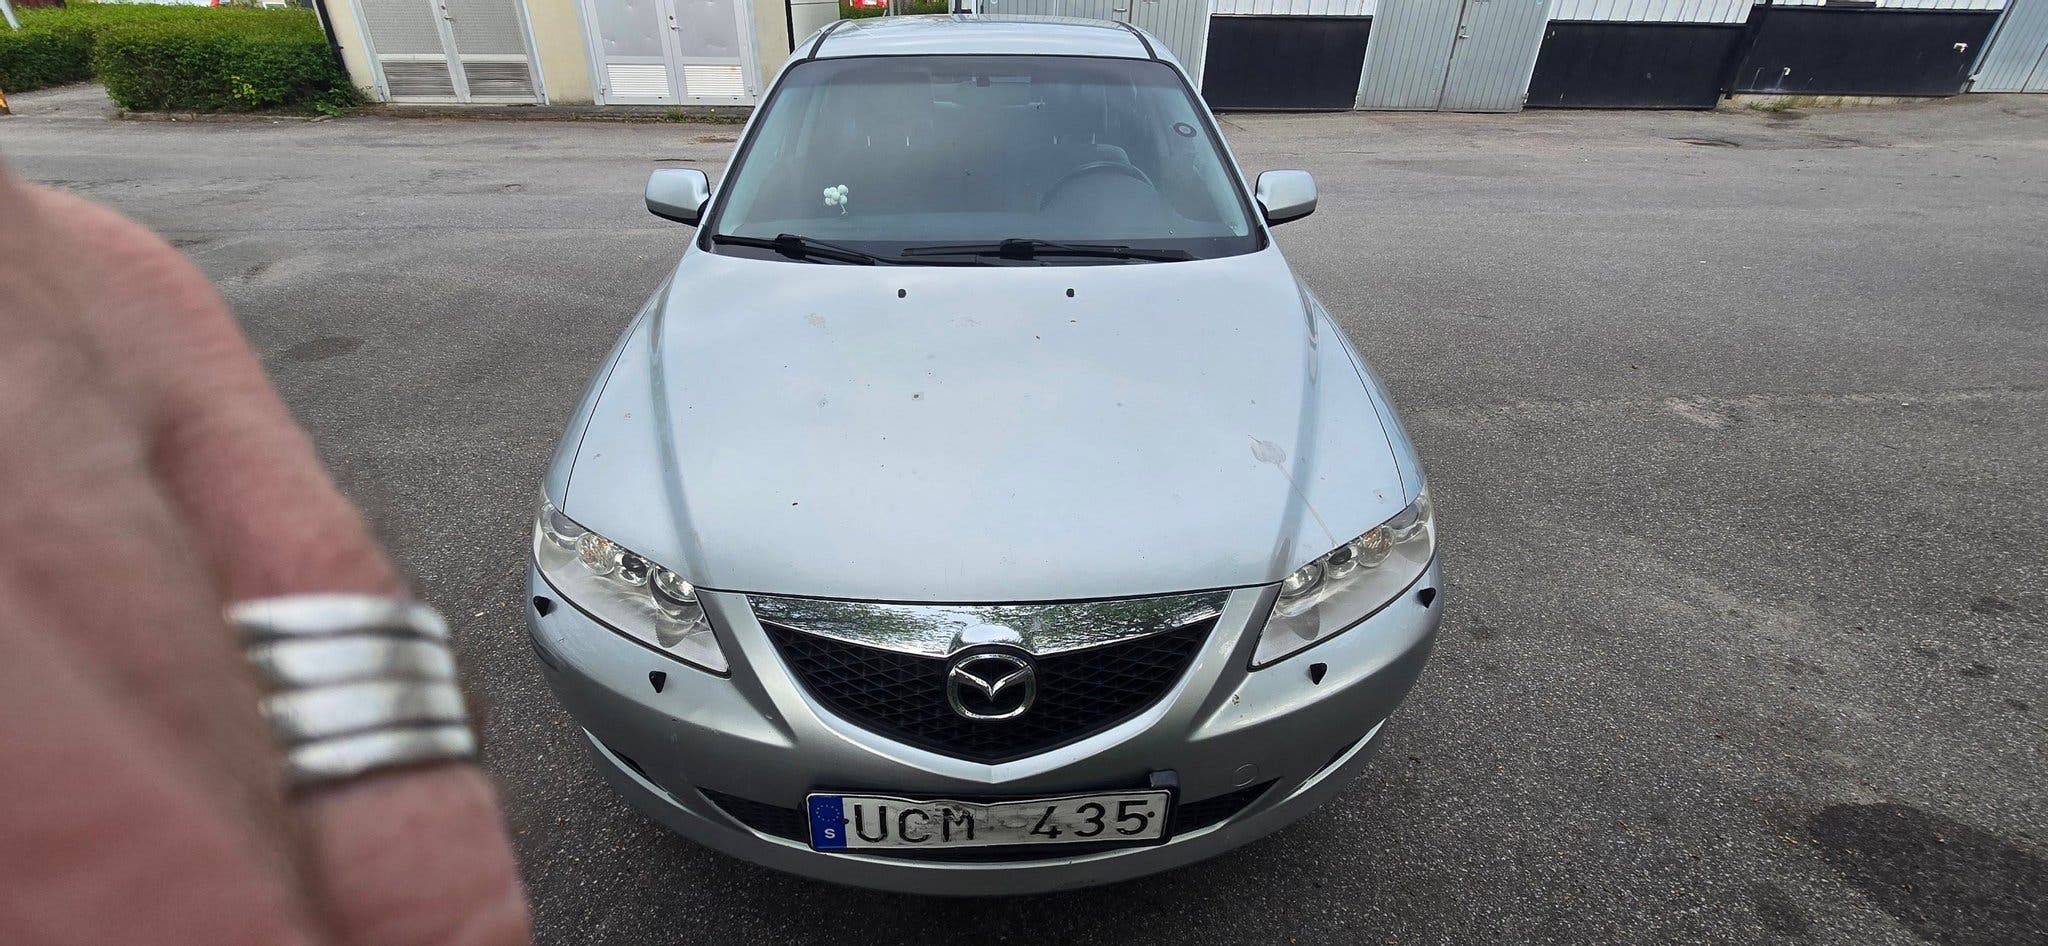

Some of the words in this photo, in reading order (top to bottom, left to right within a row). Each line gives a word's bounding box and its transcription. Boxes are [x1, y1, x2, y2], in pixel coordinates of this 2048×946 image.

[824, 828, 836, 839] S
[853, 804, 975, 843] UCM
[1030, 800, 1149, 839] 435
